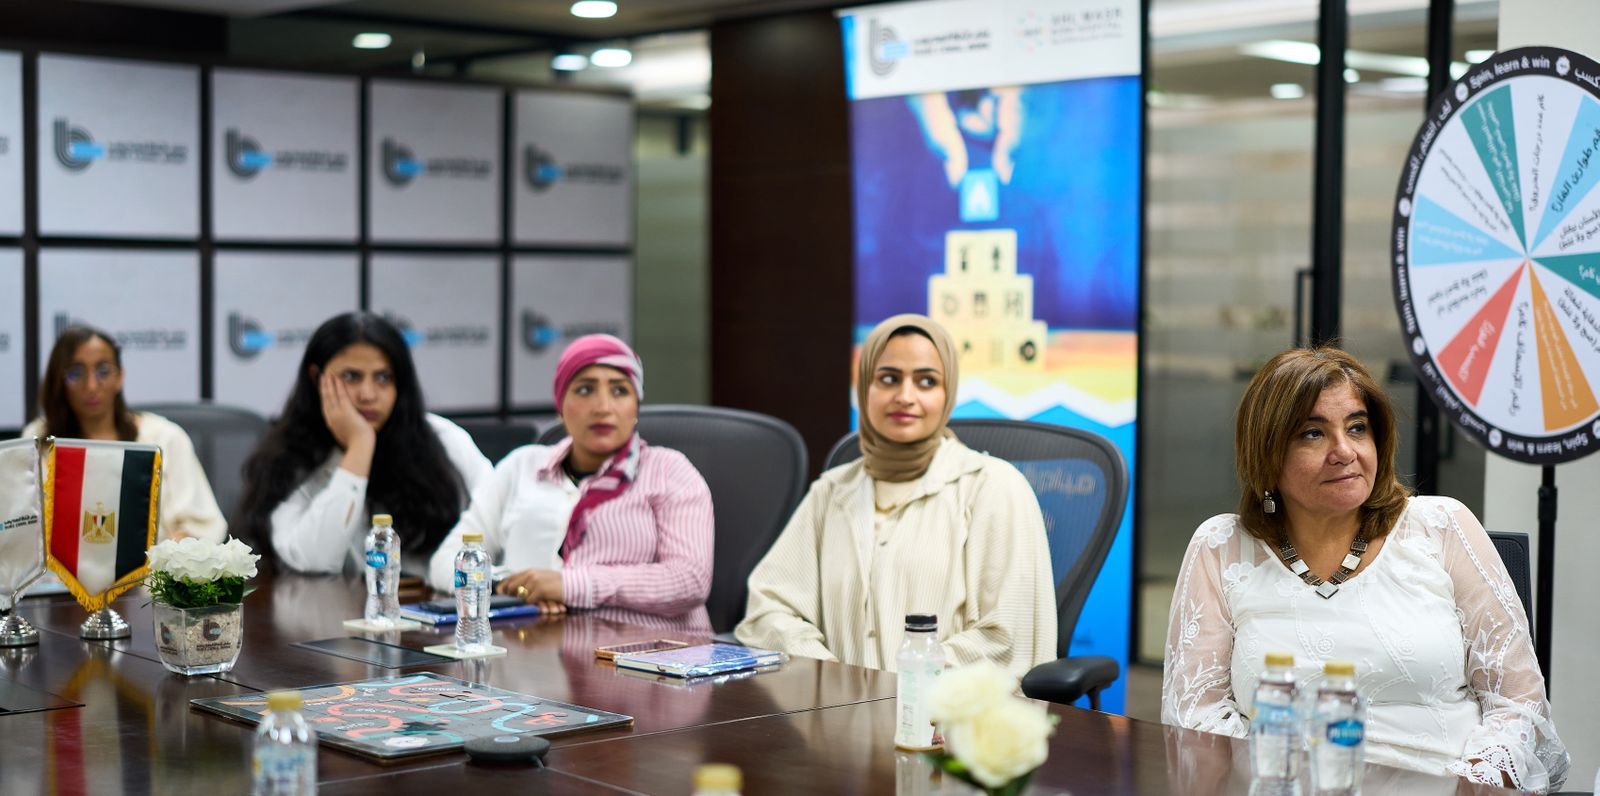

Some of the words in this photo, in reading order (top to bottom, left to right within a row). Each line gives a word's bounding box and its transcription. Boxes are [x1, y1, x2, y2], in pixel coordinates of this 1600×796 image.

[1469, 69, 1494, 89] Spin,
[1494, 59, 1520, 76] learn
[1521, 55, 1530, 69] &
[1531, 54, 1550, 69] win
[1574, 68, 1600, 89] كسب
